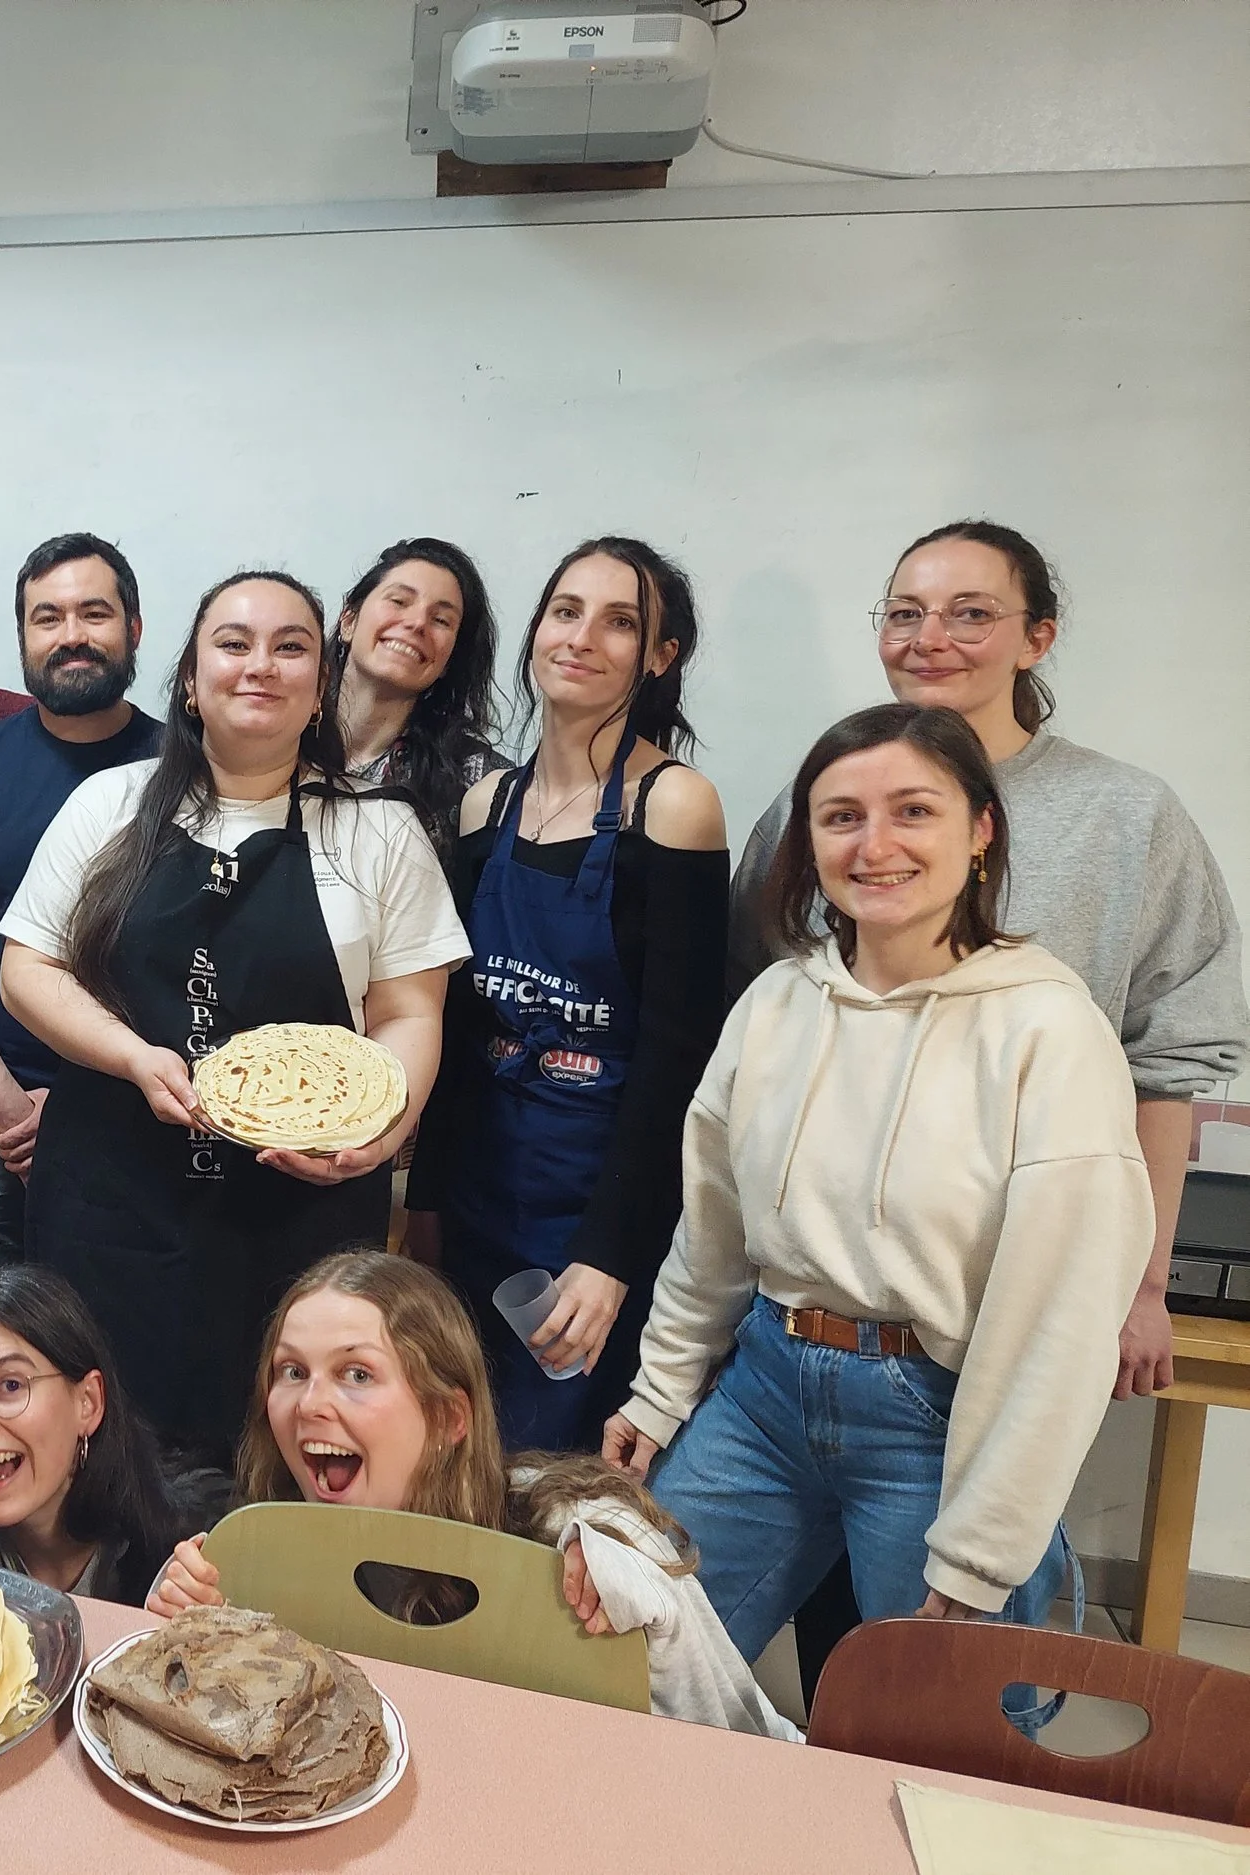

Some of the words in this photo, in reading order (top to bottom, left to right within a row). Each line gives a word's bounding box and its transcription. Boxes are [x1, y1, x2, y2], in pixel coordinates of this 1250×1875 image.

[564, 26, 604, 38] EPSON
[199, 878, 232, 899] colas)
[487, 954, 504, 968] LE
[565, 980, 581, 994] DE
[186, 977, 218, 1000] Ch
[191, 1005, 215, 1027] Pi
[545, 1049, 600, 1074] sun
[192, 1149, 221, 1172] Cs
